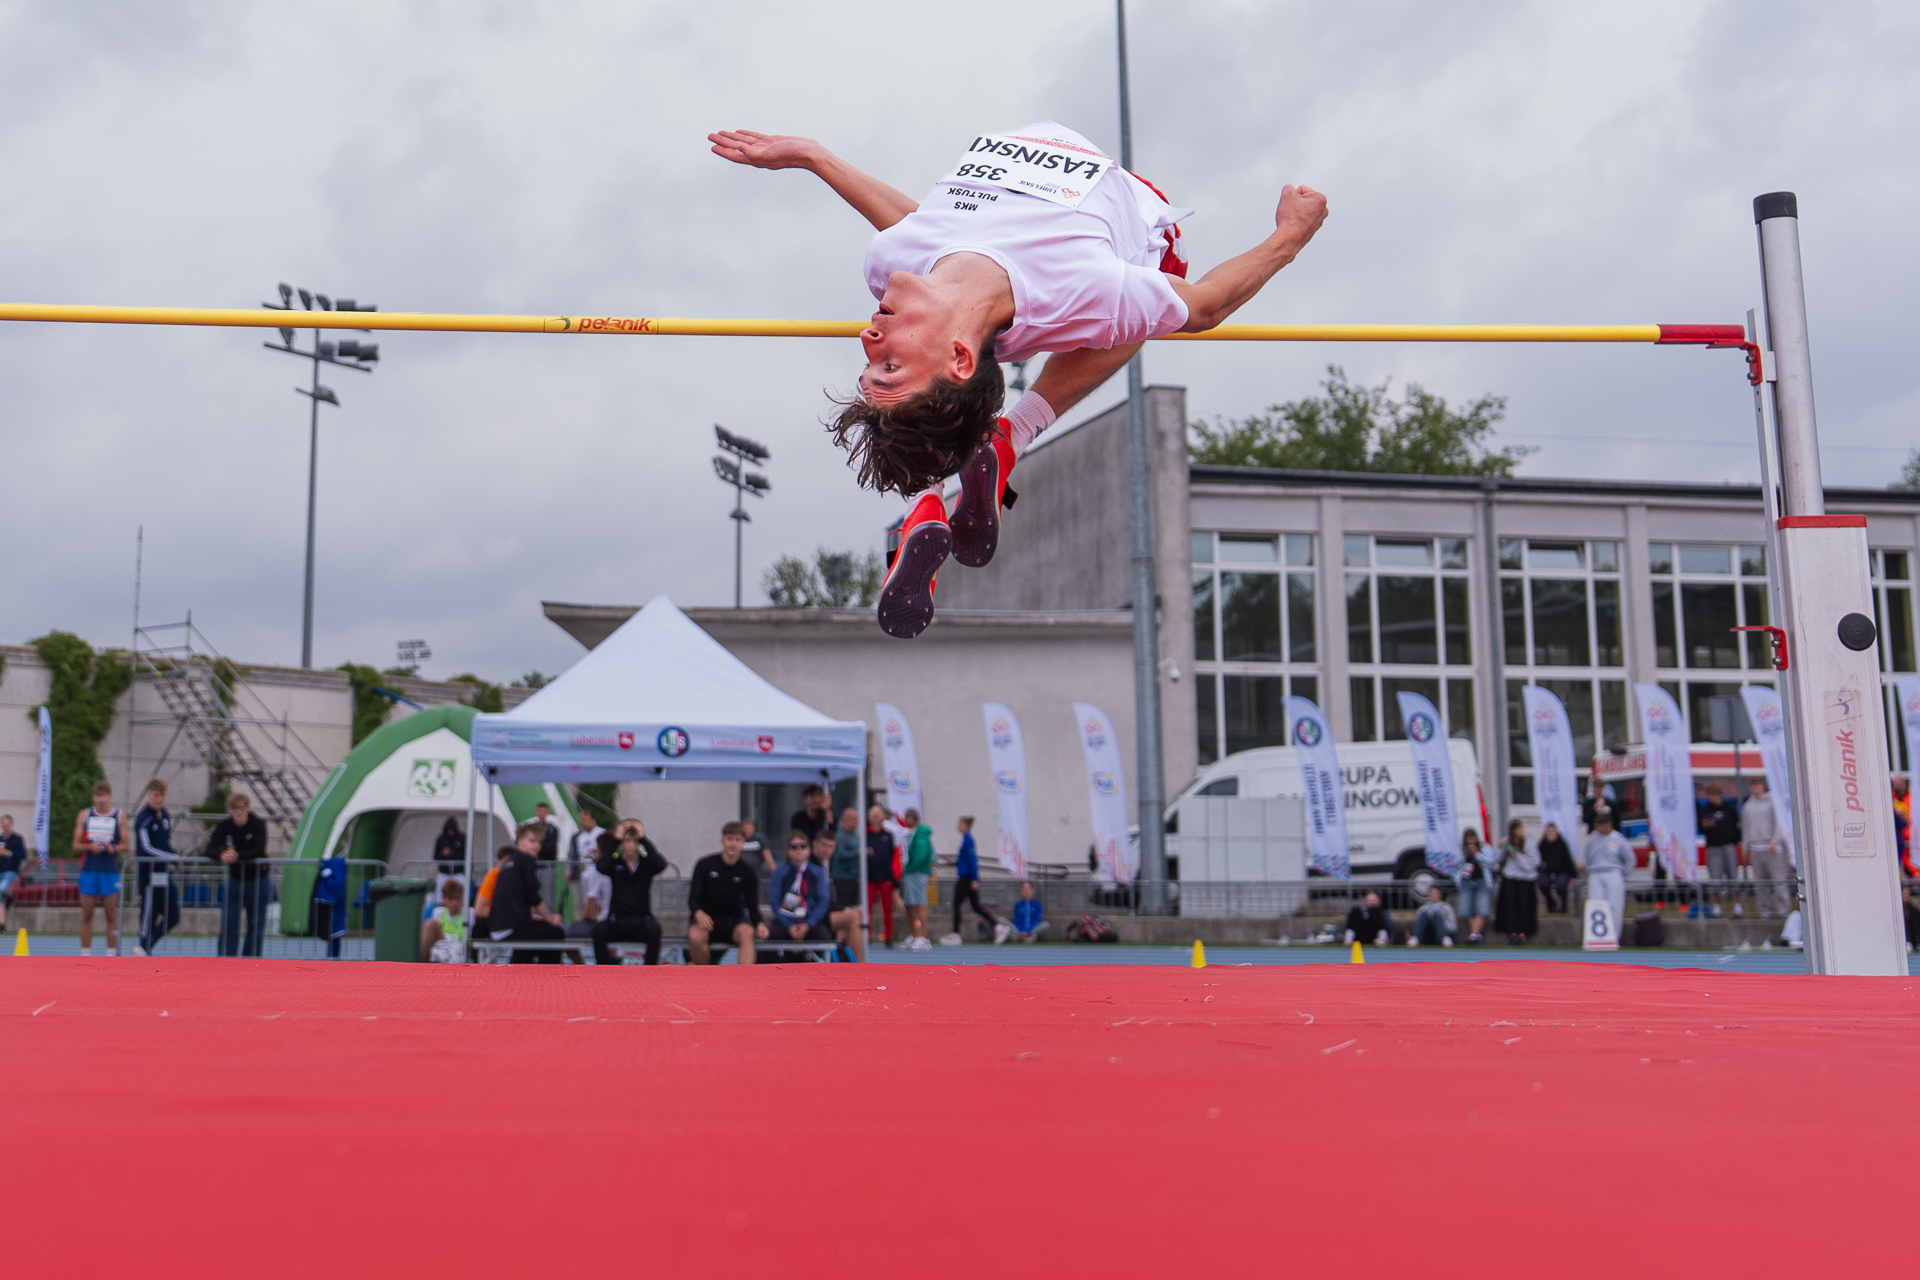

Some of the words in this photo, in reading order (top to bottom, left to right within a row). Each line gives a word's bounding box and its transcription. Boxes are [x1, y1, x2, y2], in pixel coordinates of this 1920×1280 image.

[968, 136, 1101, 180] ŁASIŃSKI
[956, 163, 1008, 181] 358
[947, 187, 998, 202] PUŁTUSK
[1018, 179, 1057, 195] LUBELSKIE
[954, 201, 978, 211] MKS
[1339, 765, 1393, 786] RUPA
[1835, 728, 1865, 812] polanik
[1591, 909, 1608, 937] 8
